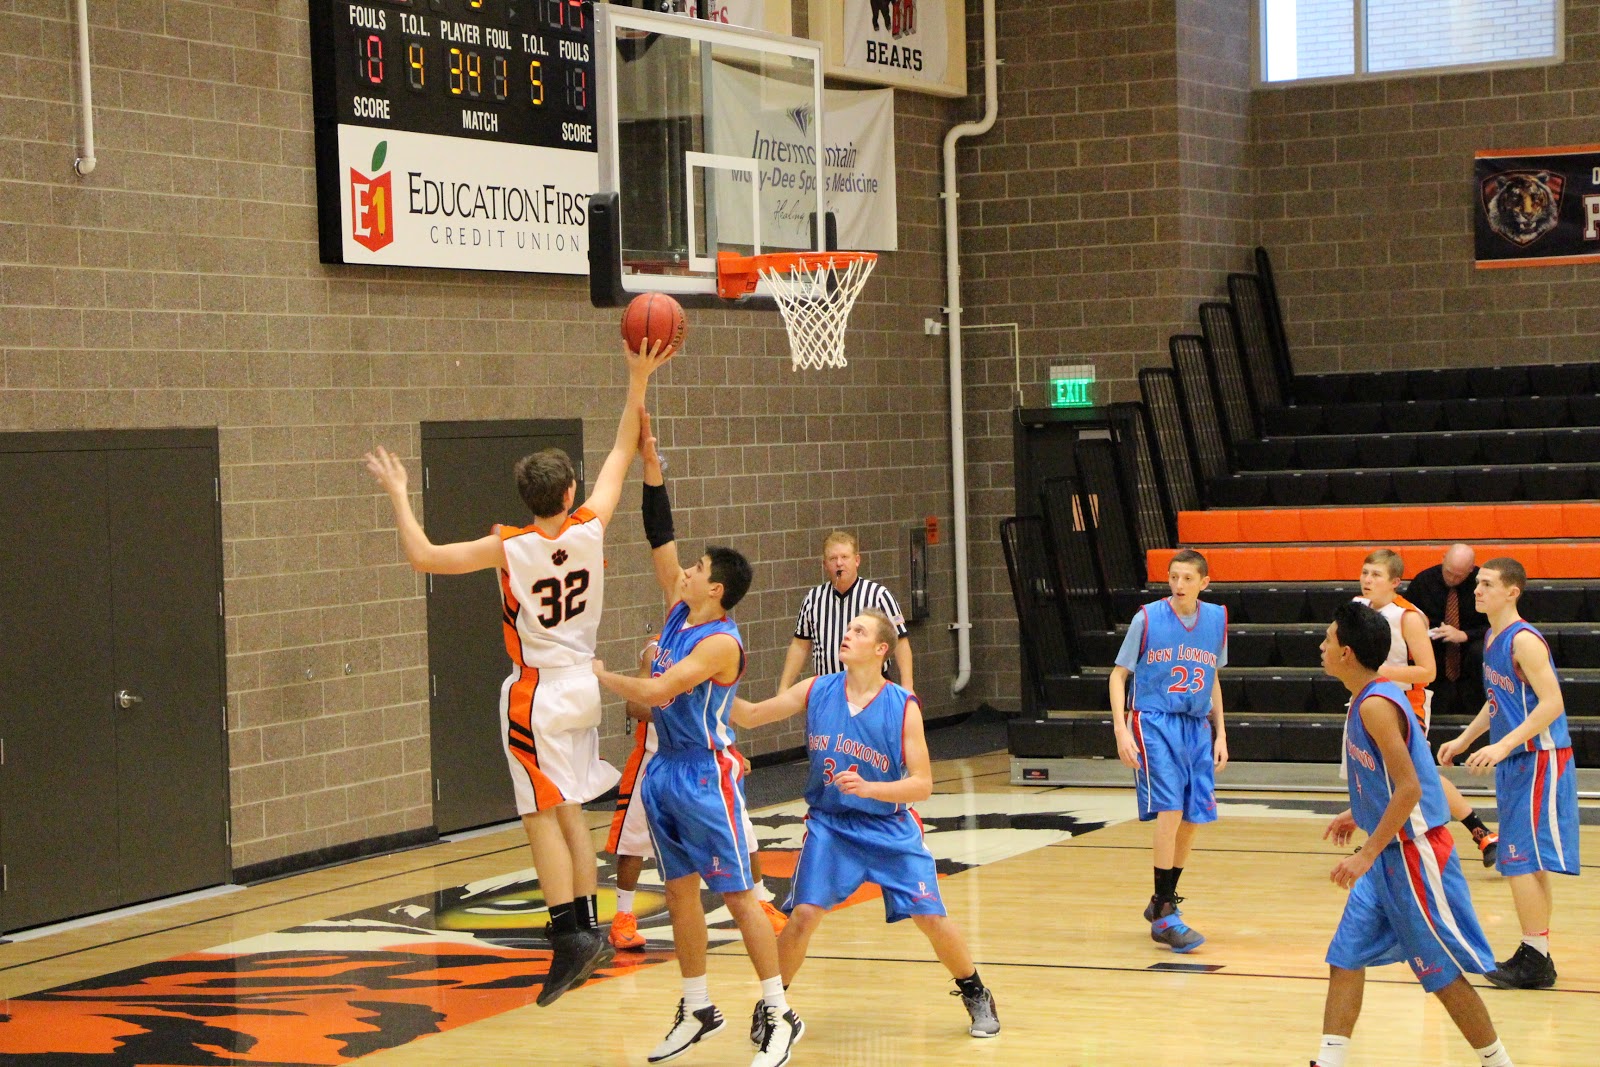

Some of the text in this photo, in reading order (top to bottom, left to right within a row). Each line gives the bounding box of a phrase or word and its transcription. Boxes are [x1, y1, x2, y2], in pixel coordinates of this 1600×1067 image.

[349, 4, 386, 30] FOULS
[399, 12, 431, 37] T.O.L.
[440, 19, 512, 50] PLAYER FOUL
[521, 33, 549, 56] T.O.L.
[559, 39, 590, 62] FOULS
[866, 39, 923, 72] BEARS
[529, 60, 544, 105] 5
[353, 95, 391, 120] SCORE
[462, 109, 499, 133] MATCH
[561, 121, 592, 144] SCORE
[752, 129, 857, 168] Intermontain
[799, 169, 831, 195] Spos
[832, 172, 878, 193] Medicine
[407, 171, 592, 226] EDUCATIONFIRS
[429, 225, 580, 252] CREDIT UNION
[1056, 379, 1088, 403] EXIT
[531, 567, 590, 630] 32
[1146, 643, 1218, 669] BEN LOMON
[1166, 664, 1206, 695] 23
[833, 732, 890, 774] LOMOND
